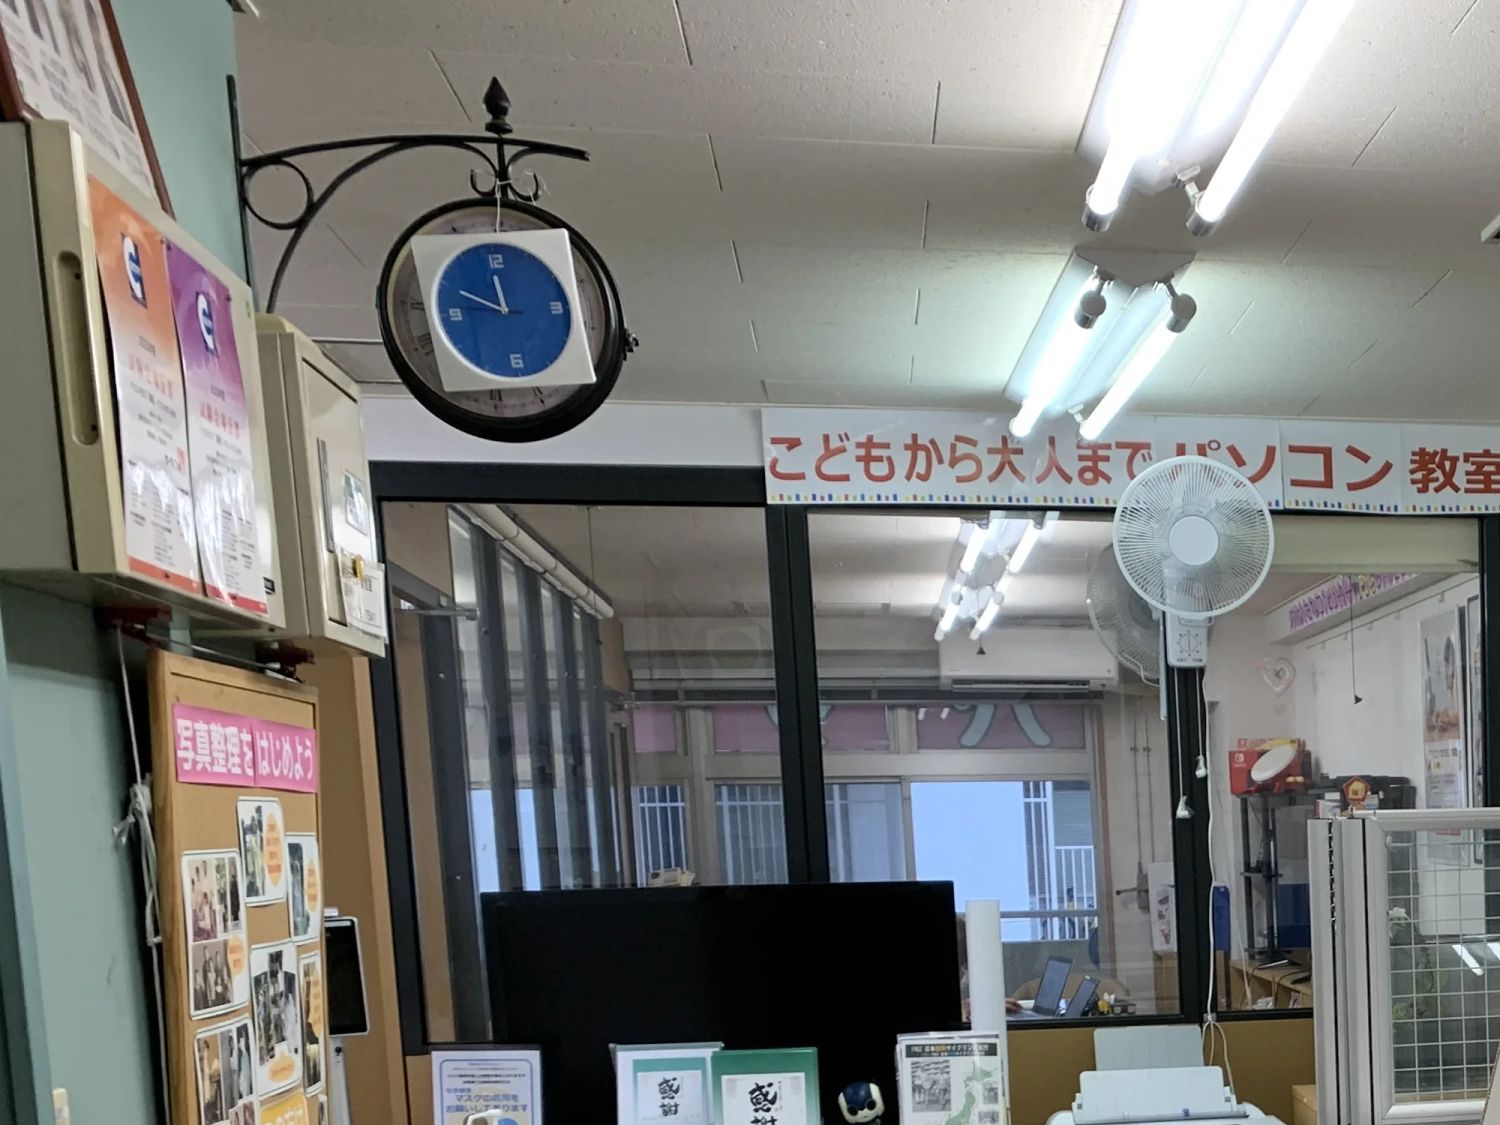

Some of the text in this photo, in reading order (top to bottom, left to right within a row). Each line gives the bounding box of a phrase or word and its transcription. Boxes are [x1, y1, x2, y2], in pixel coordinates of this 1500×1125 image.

[488, 254, 504, 268] 12
[449, 308, 463, 320] 9
[549, 301, 563, 314] 3
[509, 353, 524, 368] 6
[176, 718, 314, 781] 写真整理をはじめよう
[657, 1076, 680, 1117] 感謝
